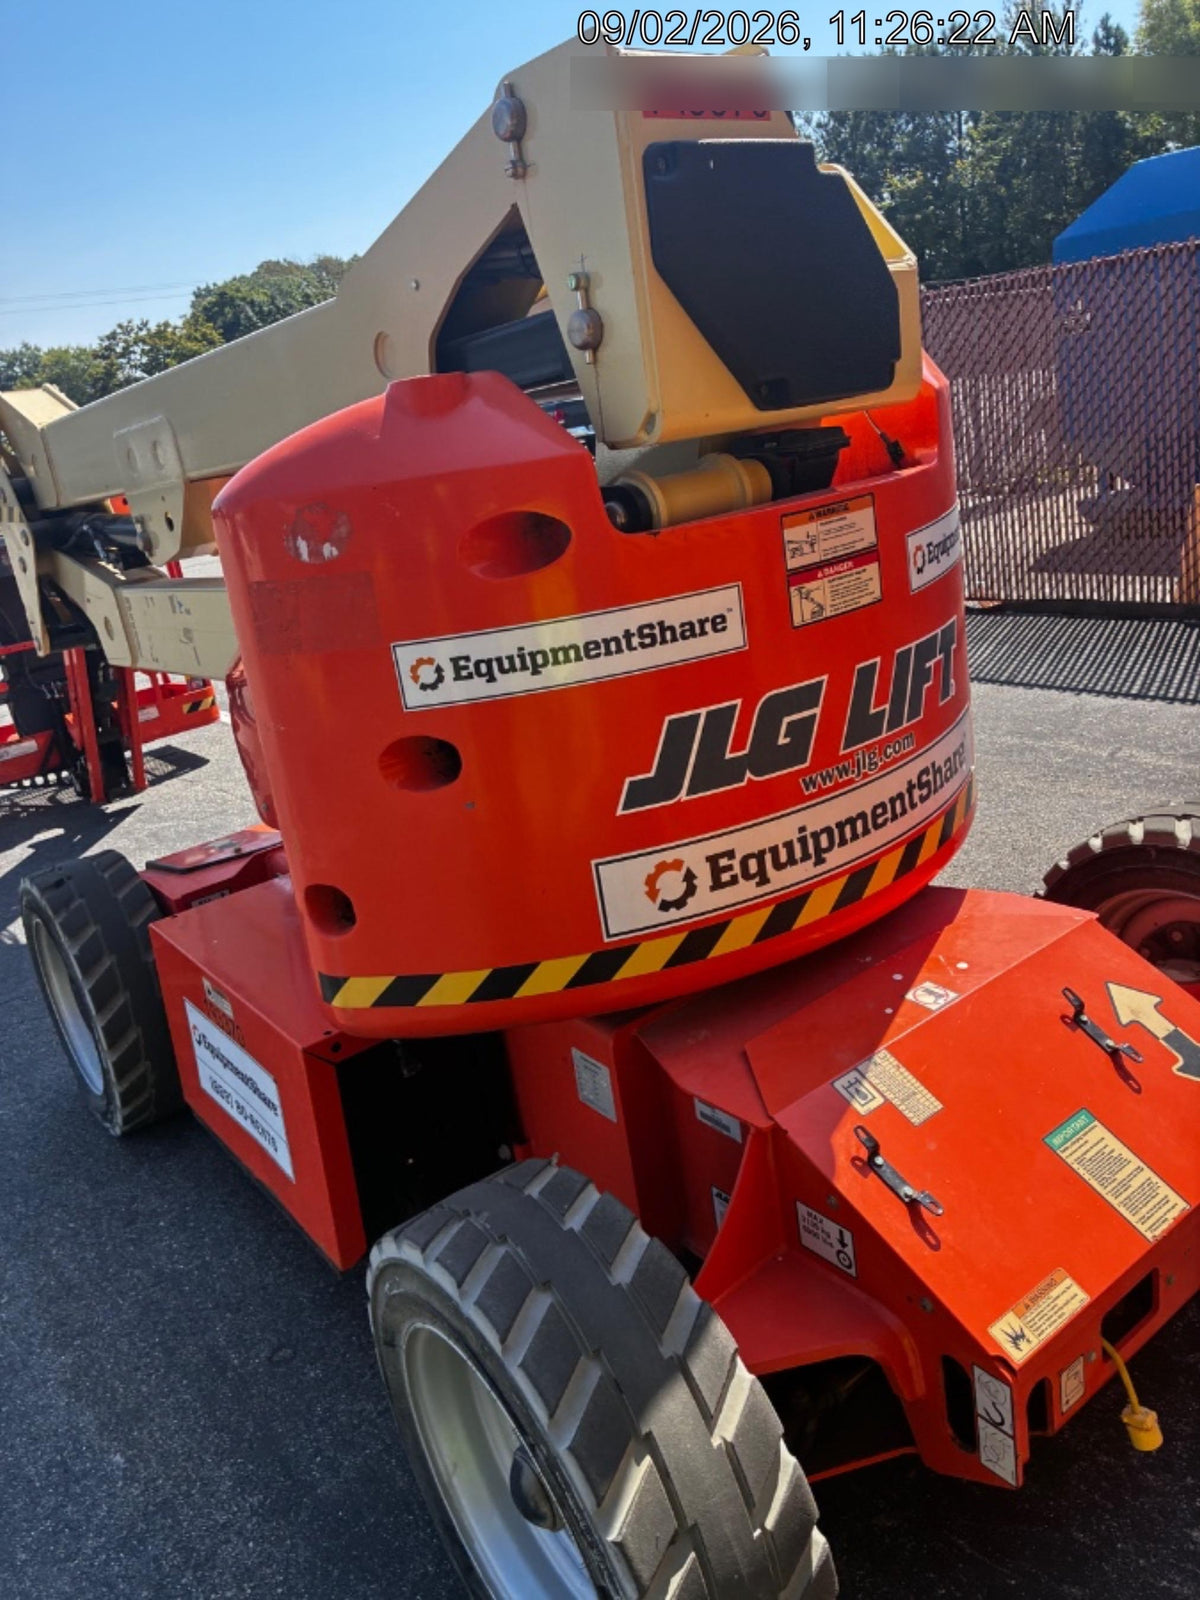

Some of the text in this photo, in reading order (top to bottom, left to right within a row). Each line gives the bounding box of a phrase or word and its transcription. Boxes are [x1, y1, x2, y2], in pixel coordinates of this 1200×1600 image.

[449, 612, 729, 684] EquipmentShare
[615, 615, 958, 816] JLG LIFT
[799, 731, 916, 796] www.jlg.com
[704, 742, 967, 893] EquipmentShare
[1052, 1115, 1090, 1146] IMPORTANT
